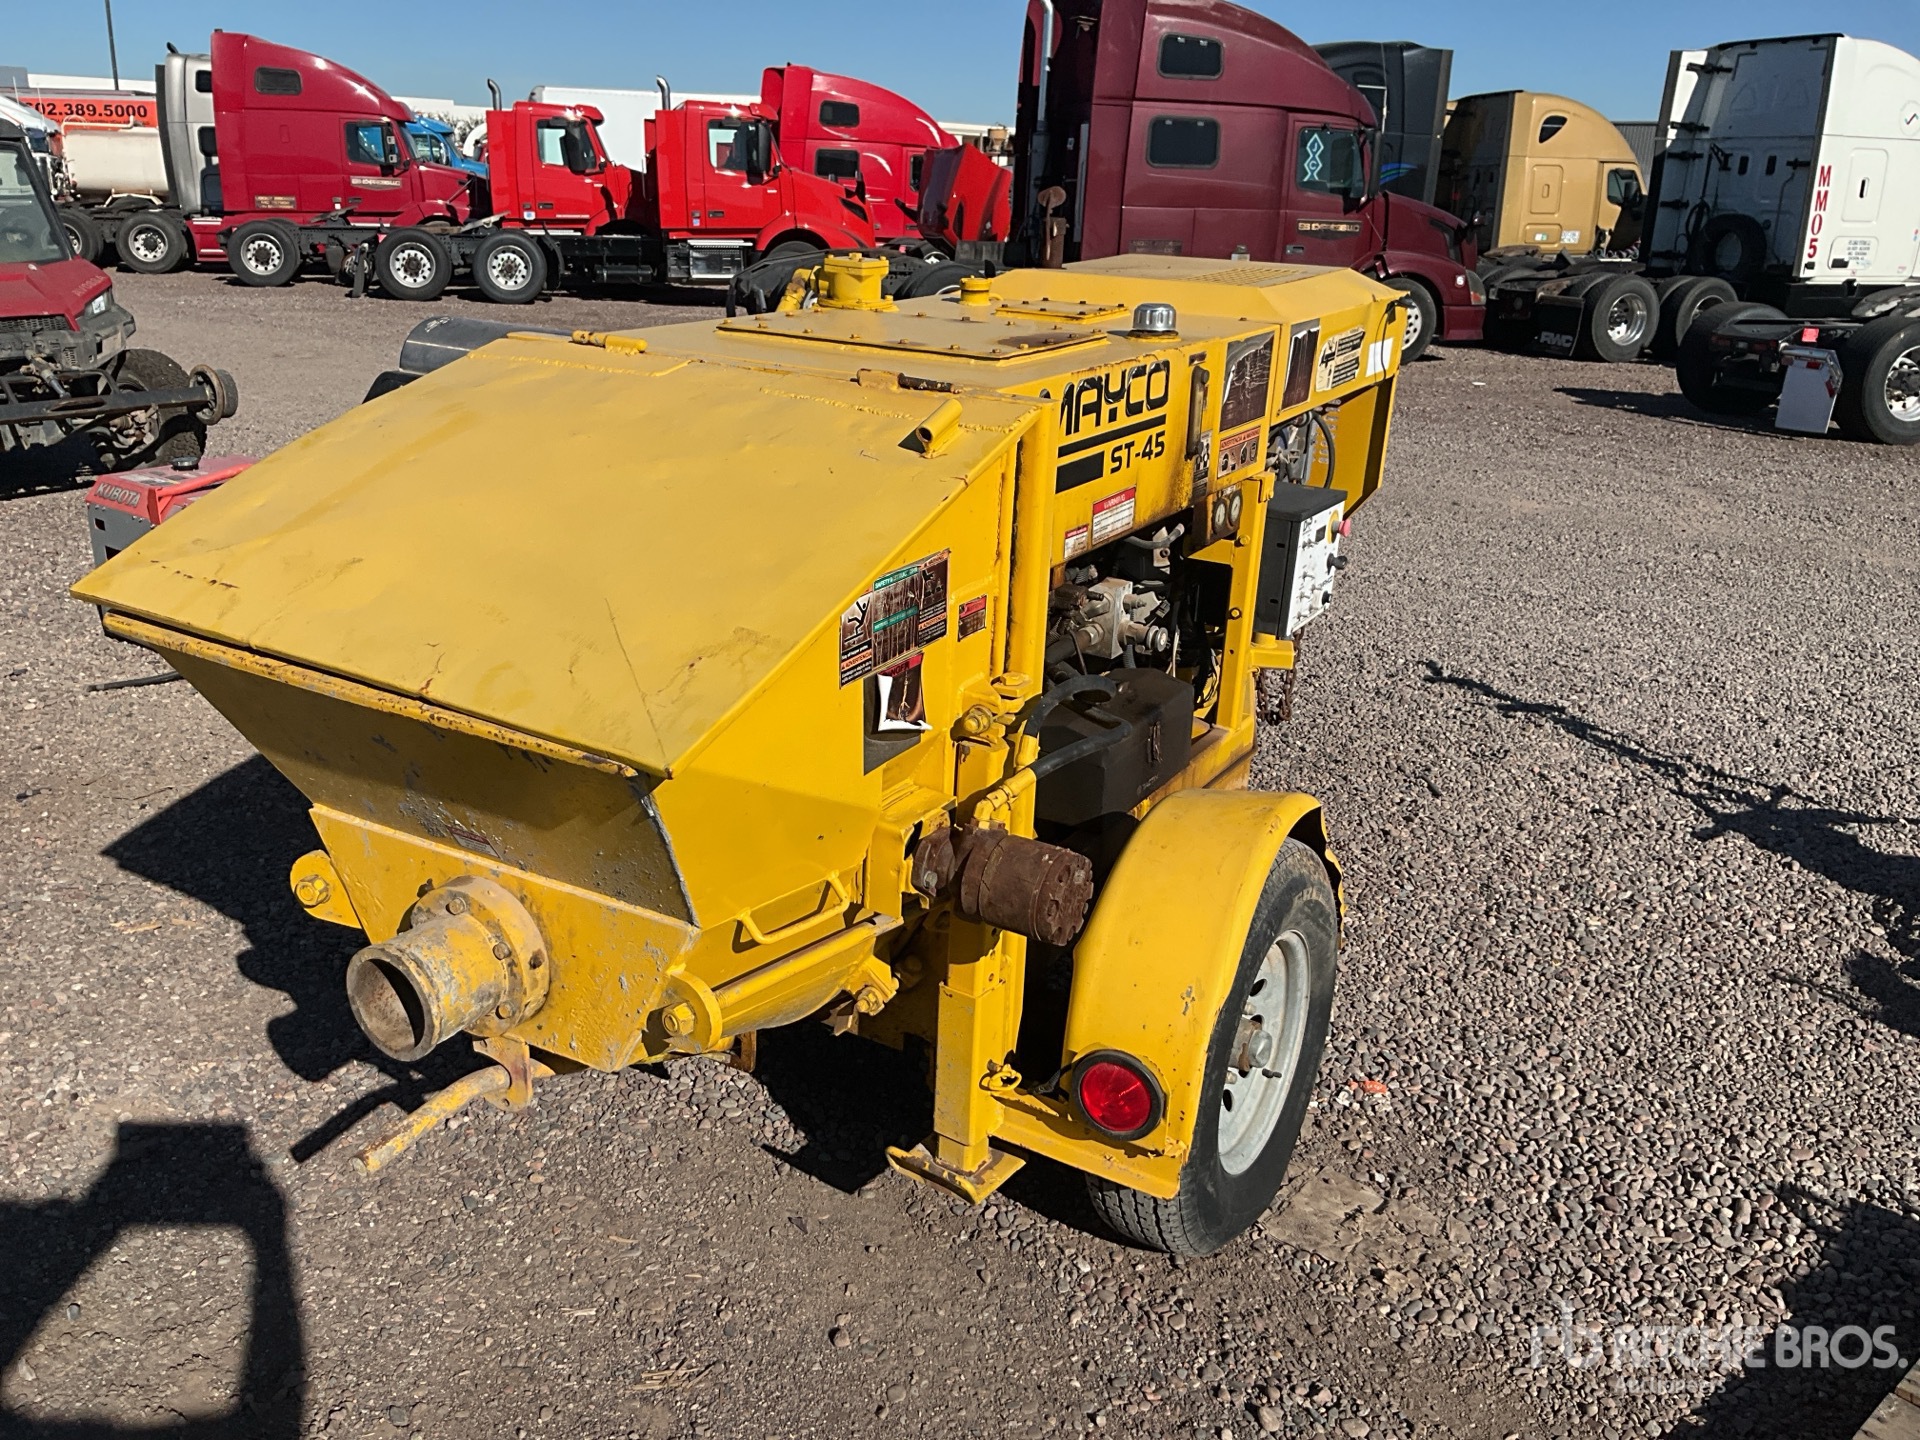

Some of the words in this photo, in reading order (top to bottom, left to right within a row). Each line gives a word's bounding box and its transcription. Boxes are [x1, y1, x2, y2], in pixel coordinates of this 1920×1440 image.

[26, 102, 148, 118] 02.389.5000
[1110, 430, 1165, 474] ST-45
[96, 482, 141, 508] KUBOTA
